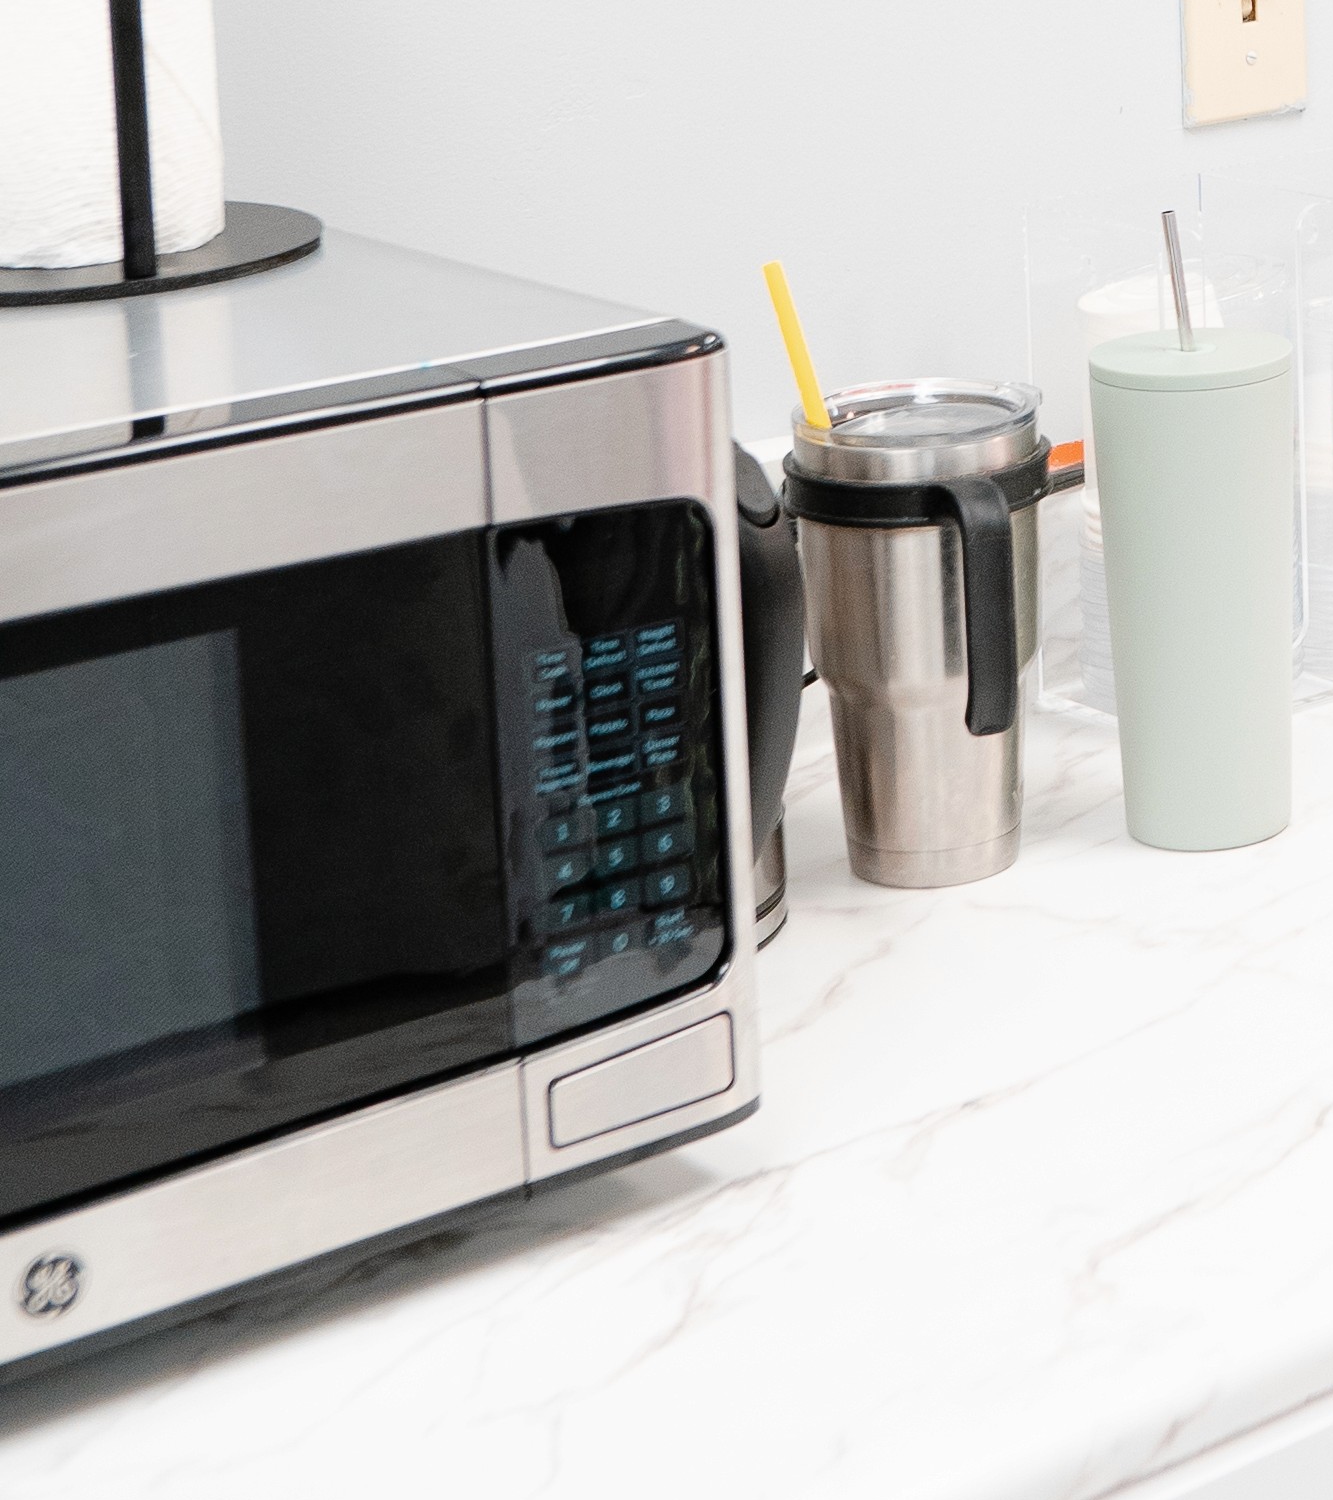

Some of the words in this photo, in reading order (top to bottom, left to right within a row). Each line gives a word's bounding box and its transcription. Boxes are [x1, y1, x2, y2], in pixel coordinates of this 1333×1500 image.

[656, 794, 671, 814] 3
[607, 808, 622, 829] 2
[658, 833, 673, 852] 6
[608, 847, 624, 867] 5
[557, 861, 573, 880] 4
[659, 874, 675, 895] 9
[611, 889, 626, 910] 8
[560, 903, 575, 924] 7
[612, 932, 629, 952] 0
